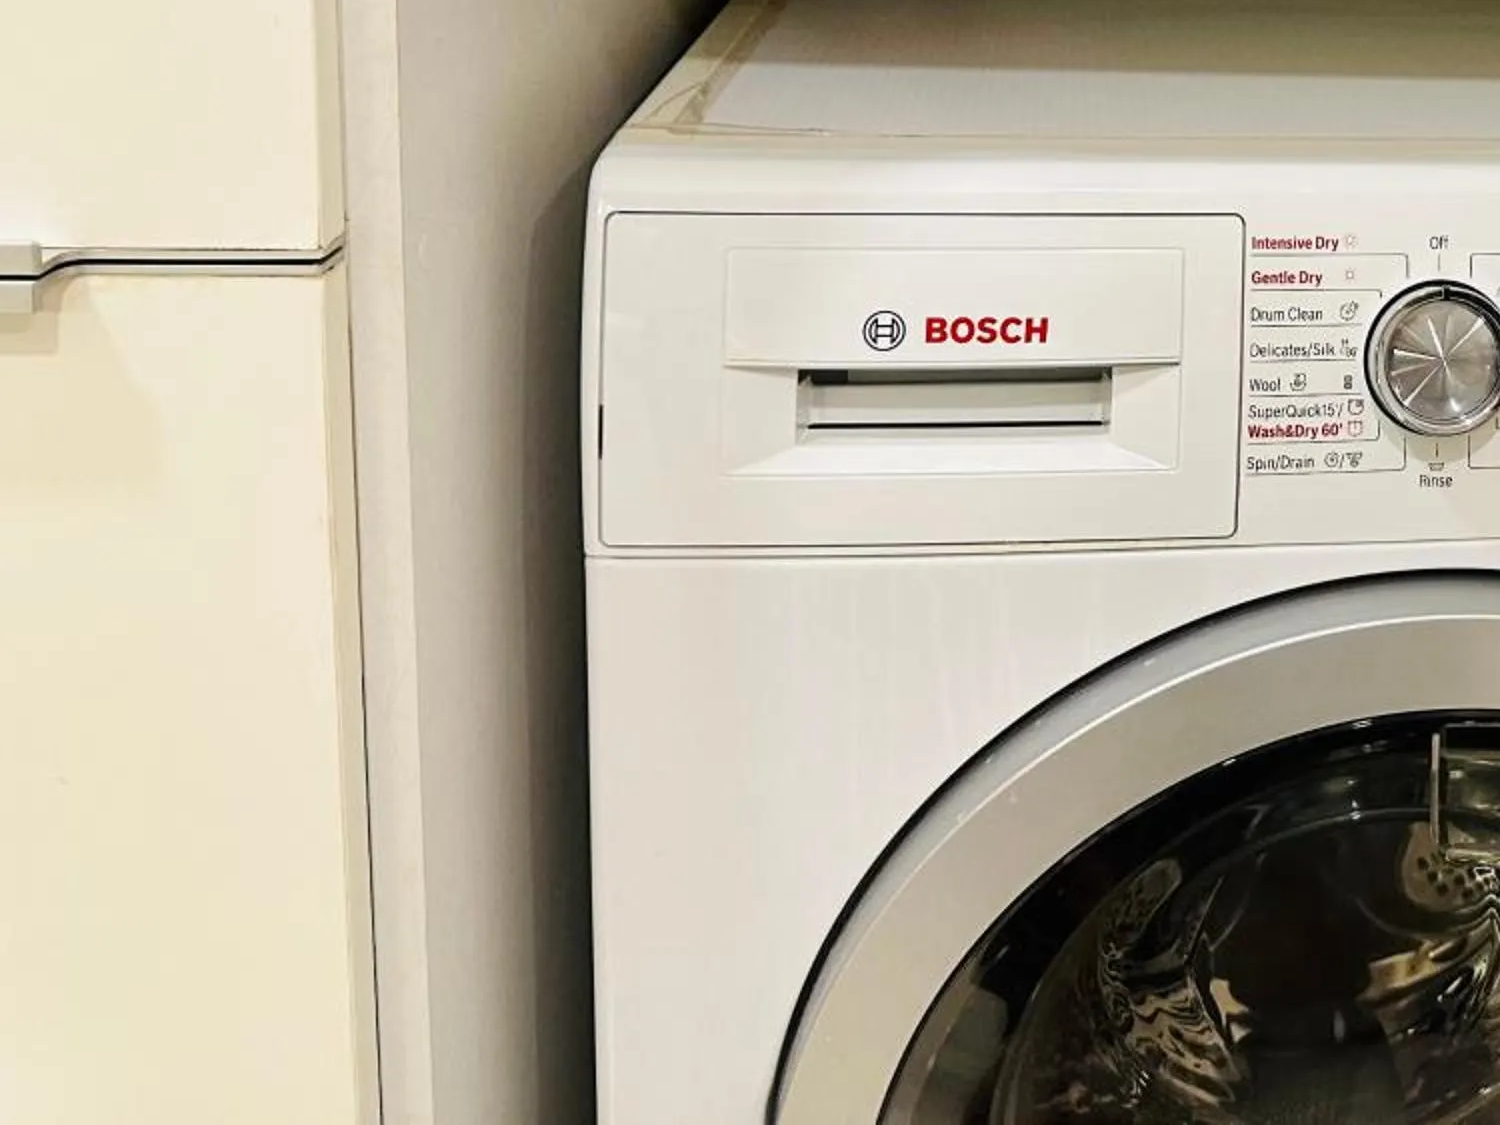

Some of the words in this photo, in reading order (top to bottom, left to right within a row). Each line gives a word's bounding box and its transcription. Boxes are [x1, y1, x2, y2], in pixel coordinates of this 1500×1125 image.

[1251, 236, 1313, 250] Intensive
[1315, 236, 1340, 252] Dry
[1429, 235, 1449, 250] Off
[1251, 270, 1297, 284] Gentle
[1299, 270, 1323, 287] Dry
[1251, 306, 1285, 322] Drum
[1287, 306, 1323, 321] Clean
[924, 316, 1050, 344] BOSCH
[1250, 342, 1336, 358] Delicates/Silk
[1249, 378, 1281, 392] Wool
[1248, 424, 1319, 440] Wash&Dry
[1247, 455, 1316, 472] Spin/Drain
[1419, 474, 1453, 487] Rinse
